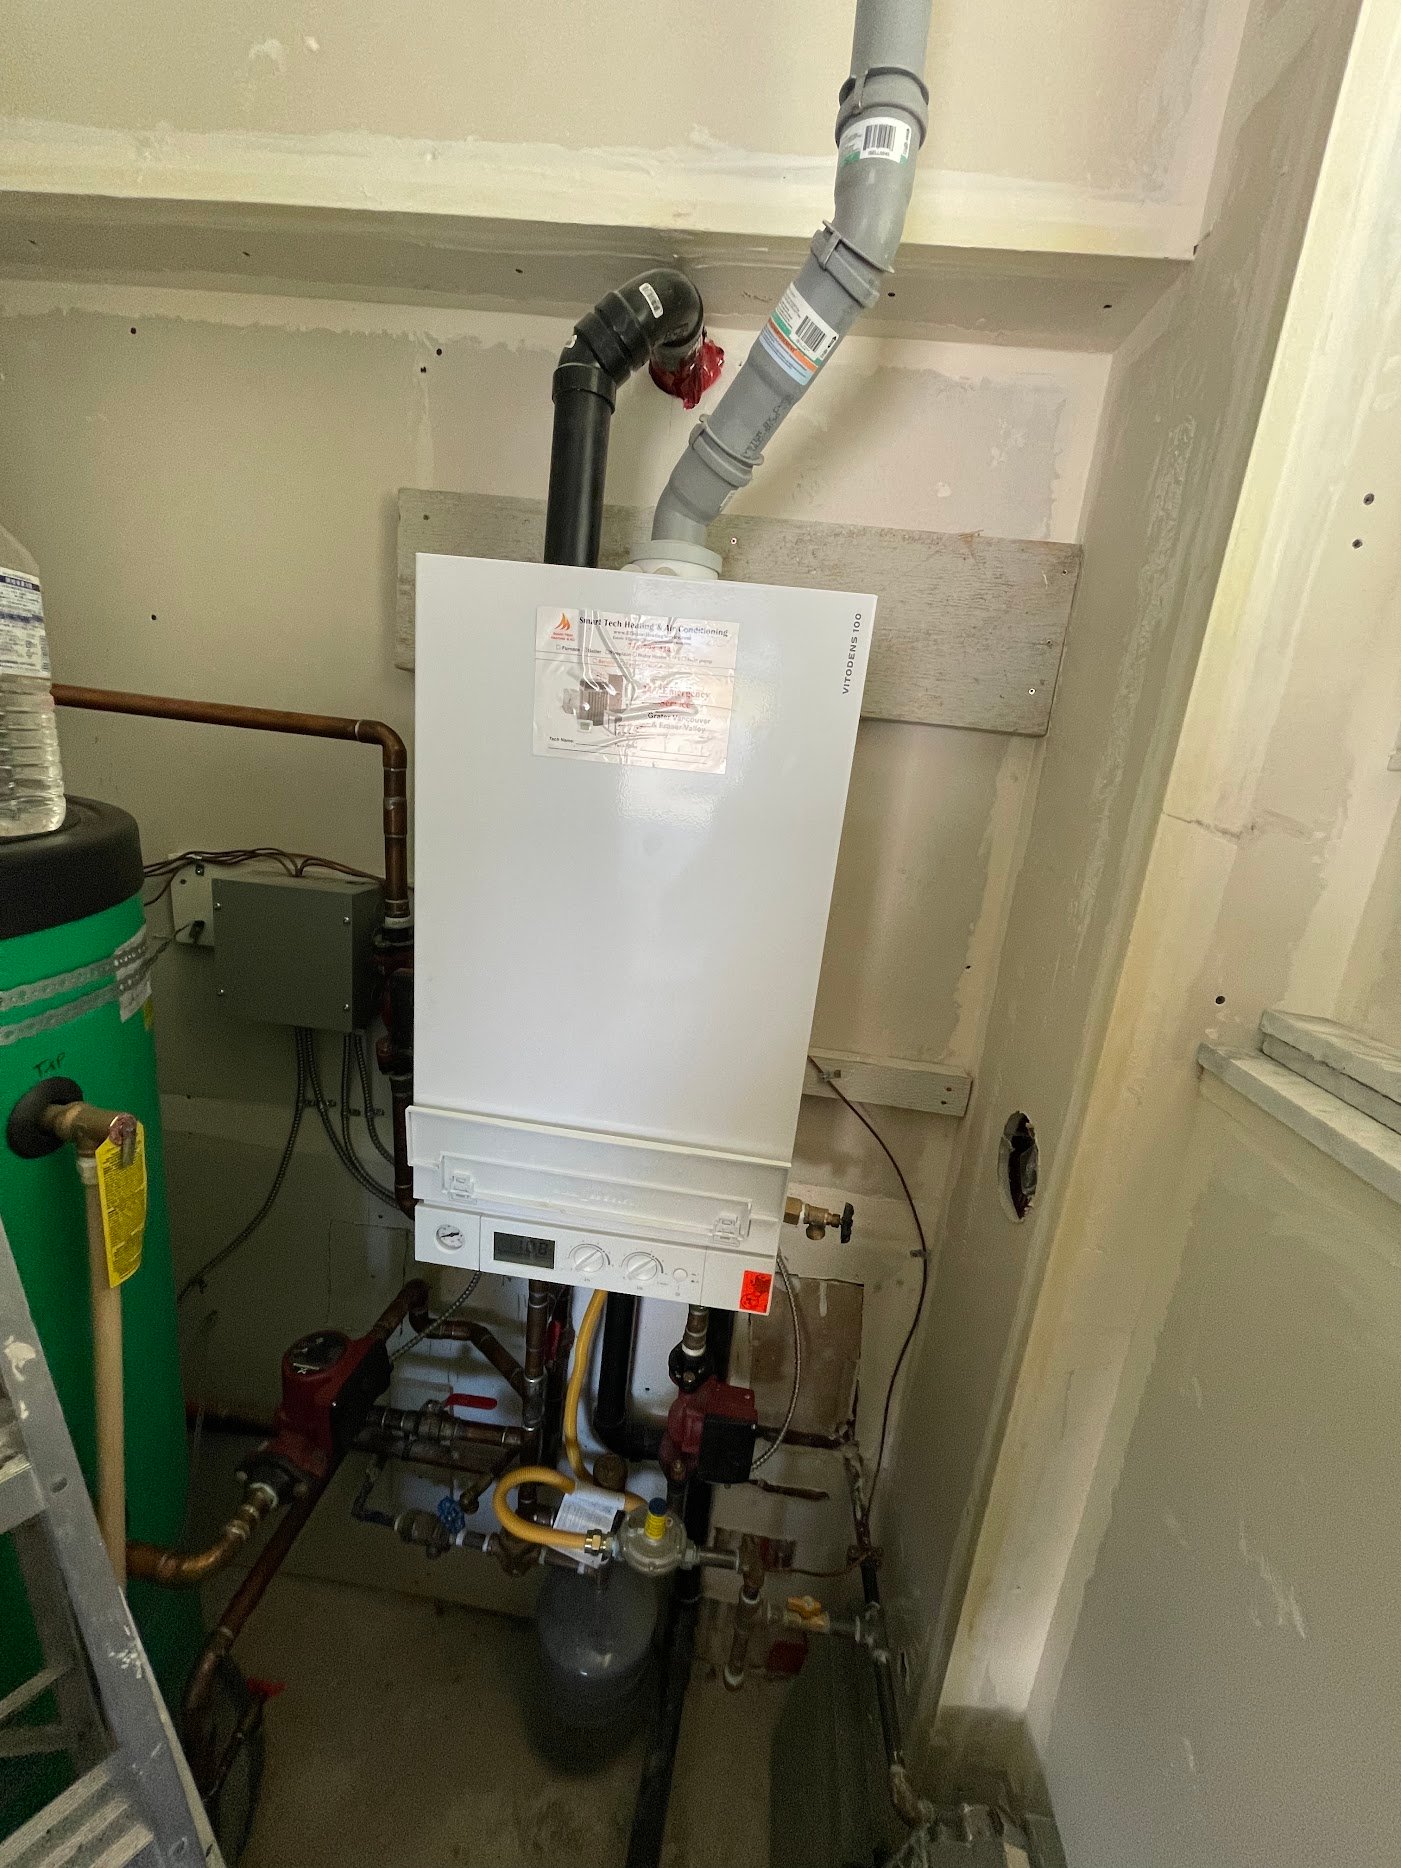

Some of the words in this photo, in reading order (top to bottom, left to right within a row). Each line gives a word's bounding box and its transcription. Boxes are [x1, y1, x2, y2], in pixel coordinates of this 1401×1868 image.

[579, 616, 601, 626] Smart
[604, 618, 622, 628] Tech
[624, 620, 655, 632] Heating
[657, 623, 662, 631] &
[678, 625, 729, 638] Conditioning
[842, 636, 858, 695] VITODENS
[853, 613, 862, 633] 100
[662, 686, 711, 701] Emergency
[672, 714, 711, 724] Vancouver
[683, 723, 706, 733] Valley
